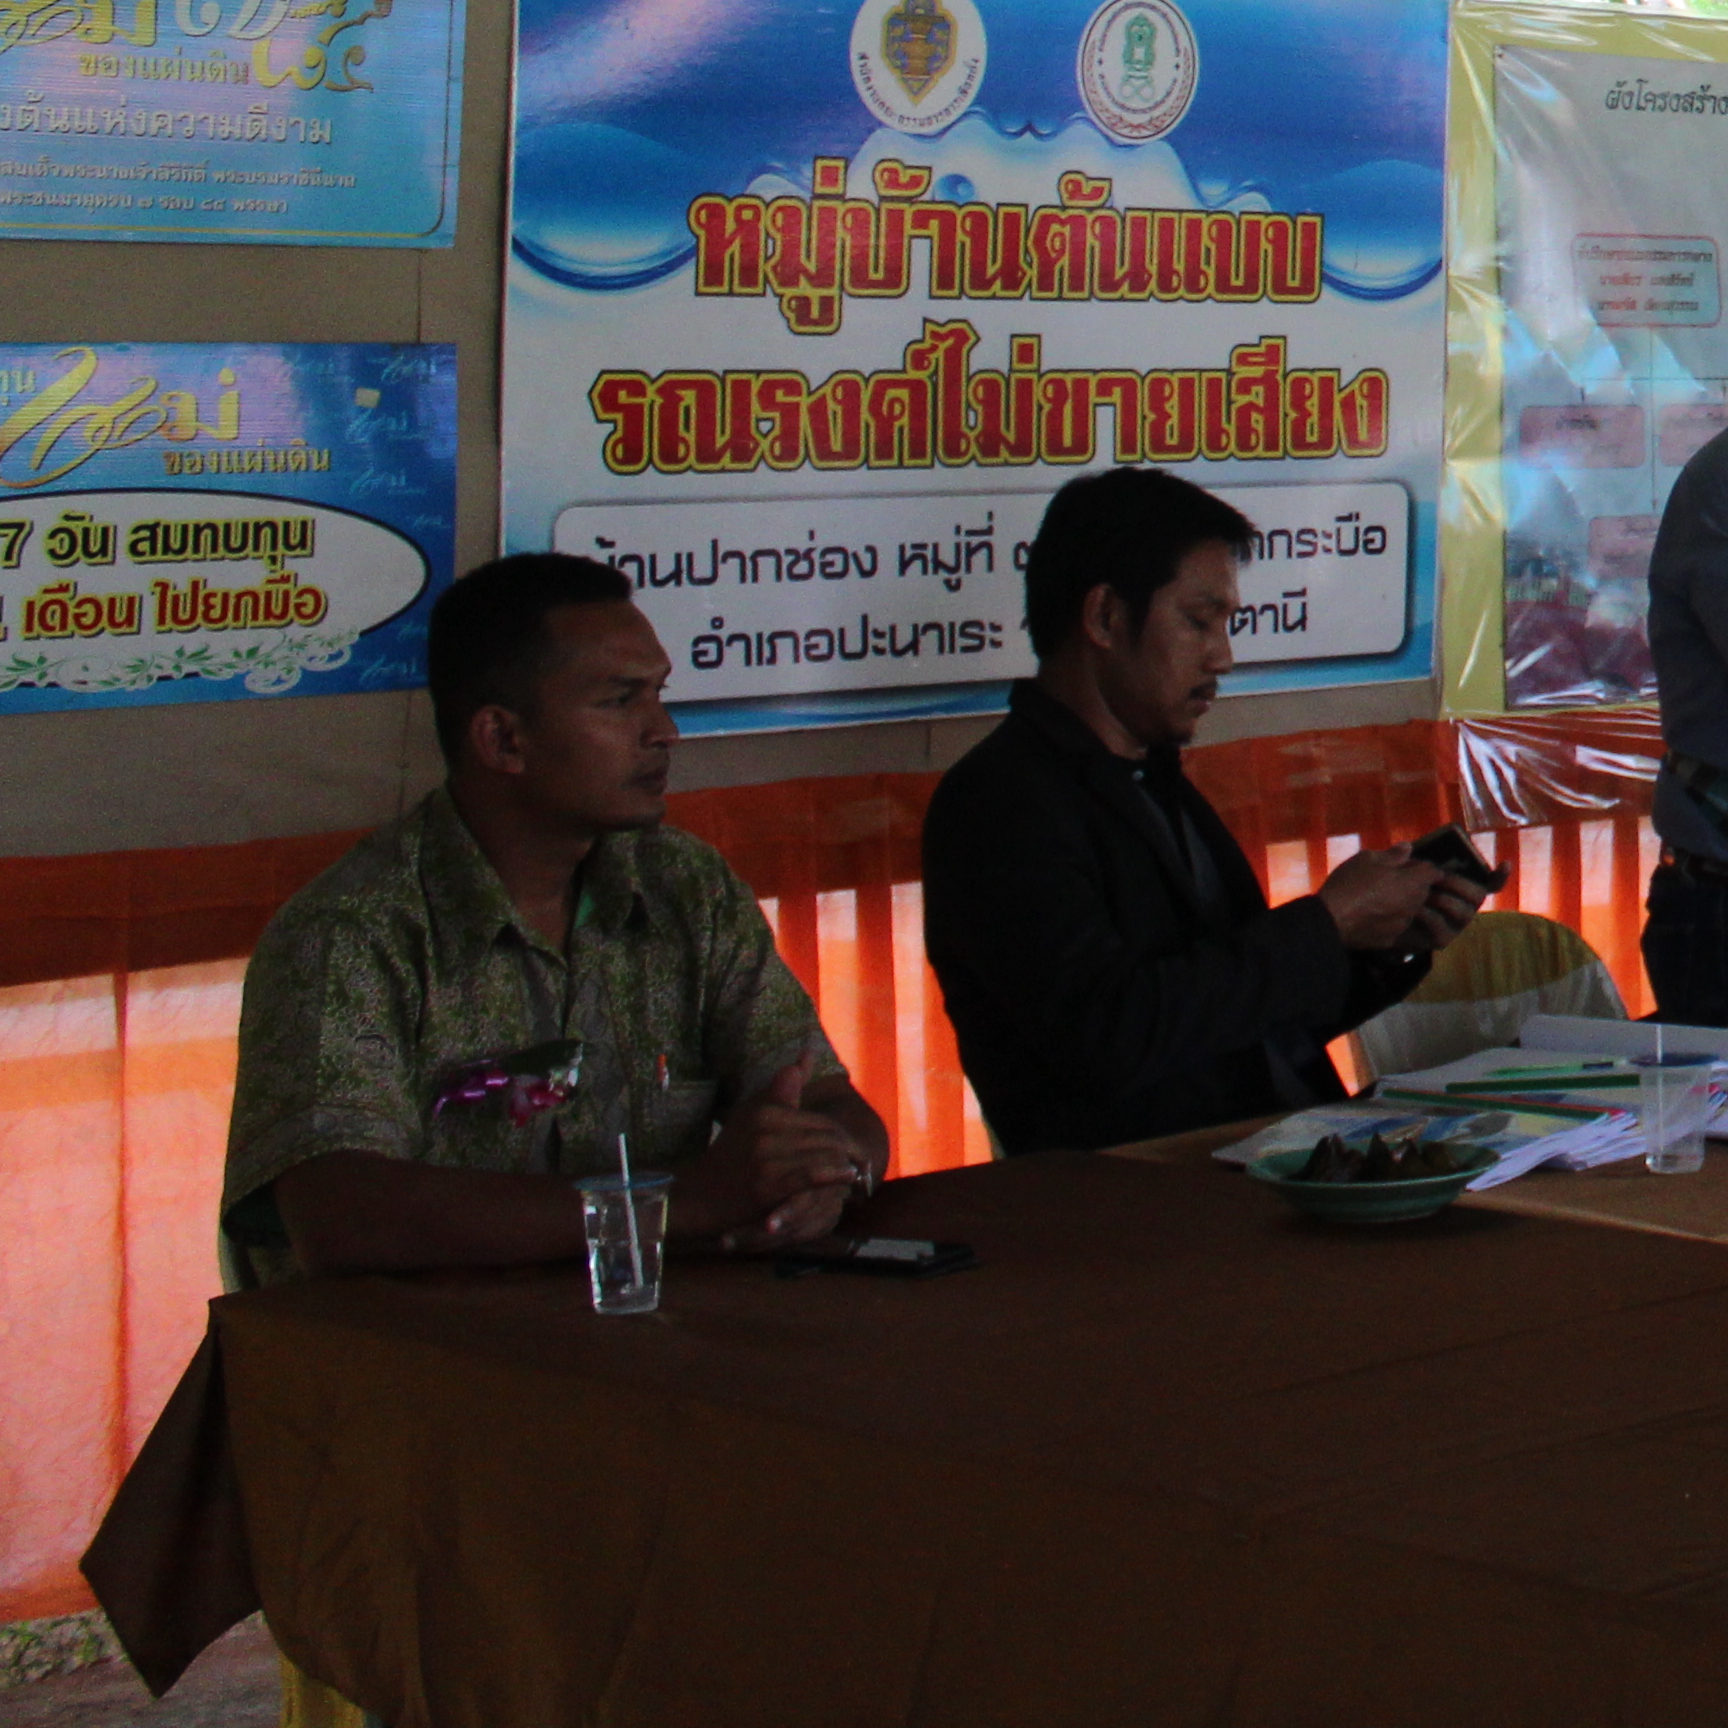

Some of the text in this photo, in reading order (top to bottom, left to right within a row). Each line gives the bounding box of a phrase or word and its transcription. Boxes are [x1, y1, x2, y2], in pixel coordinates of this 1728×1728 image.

[80, 48, 250, 84] ของแผ่นดิน
[687, 156, 1325, 335] หมู่บ้านต้นแบบ
[590, 317, 1390, 474] รณรงค์ไม่ขายเสียง
[163, 439, 331, 475] ของแผ่นดิน
[46, 512, 115, 567] วัน
[128, 516, 315, 572] สมทบทุน
[595, 530, 877, 590] ้านปากช่อง
[896, 512, 996, 593] หมู่ที่
[23, 581, 141, 639] เดือน
[152, 574, 328, 632] ไปยกมือ
[690, 615, 1003, 672] อำเภอปะนาเระ
